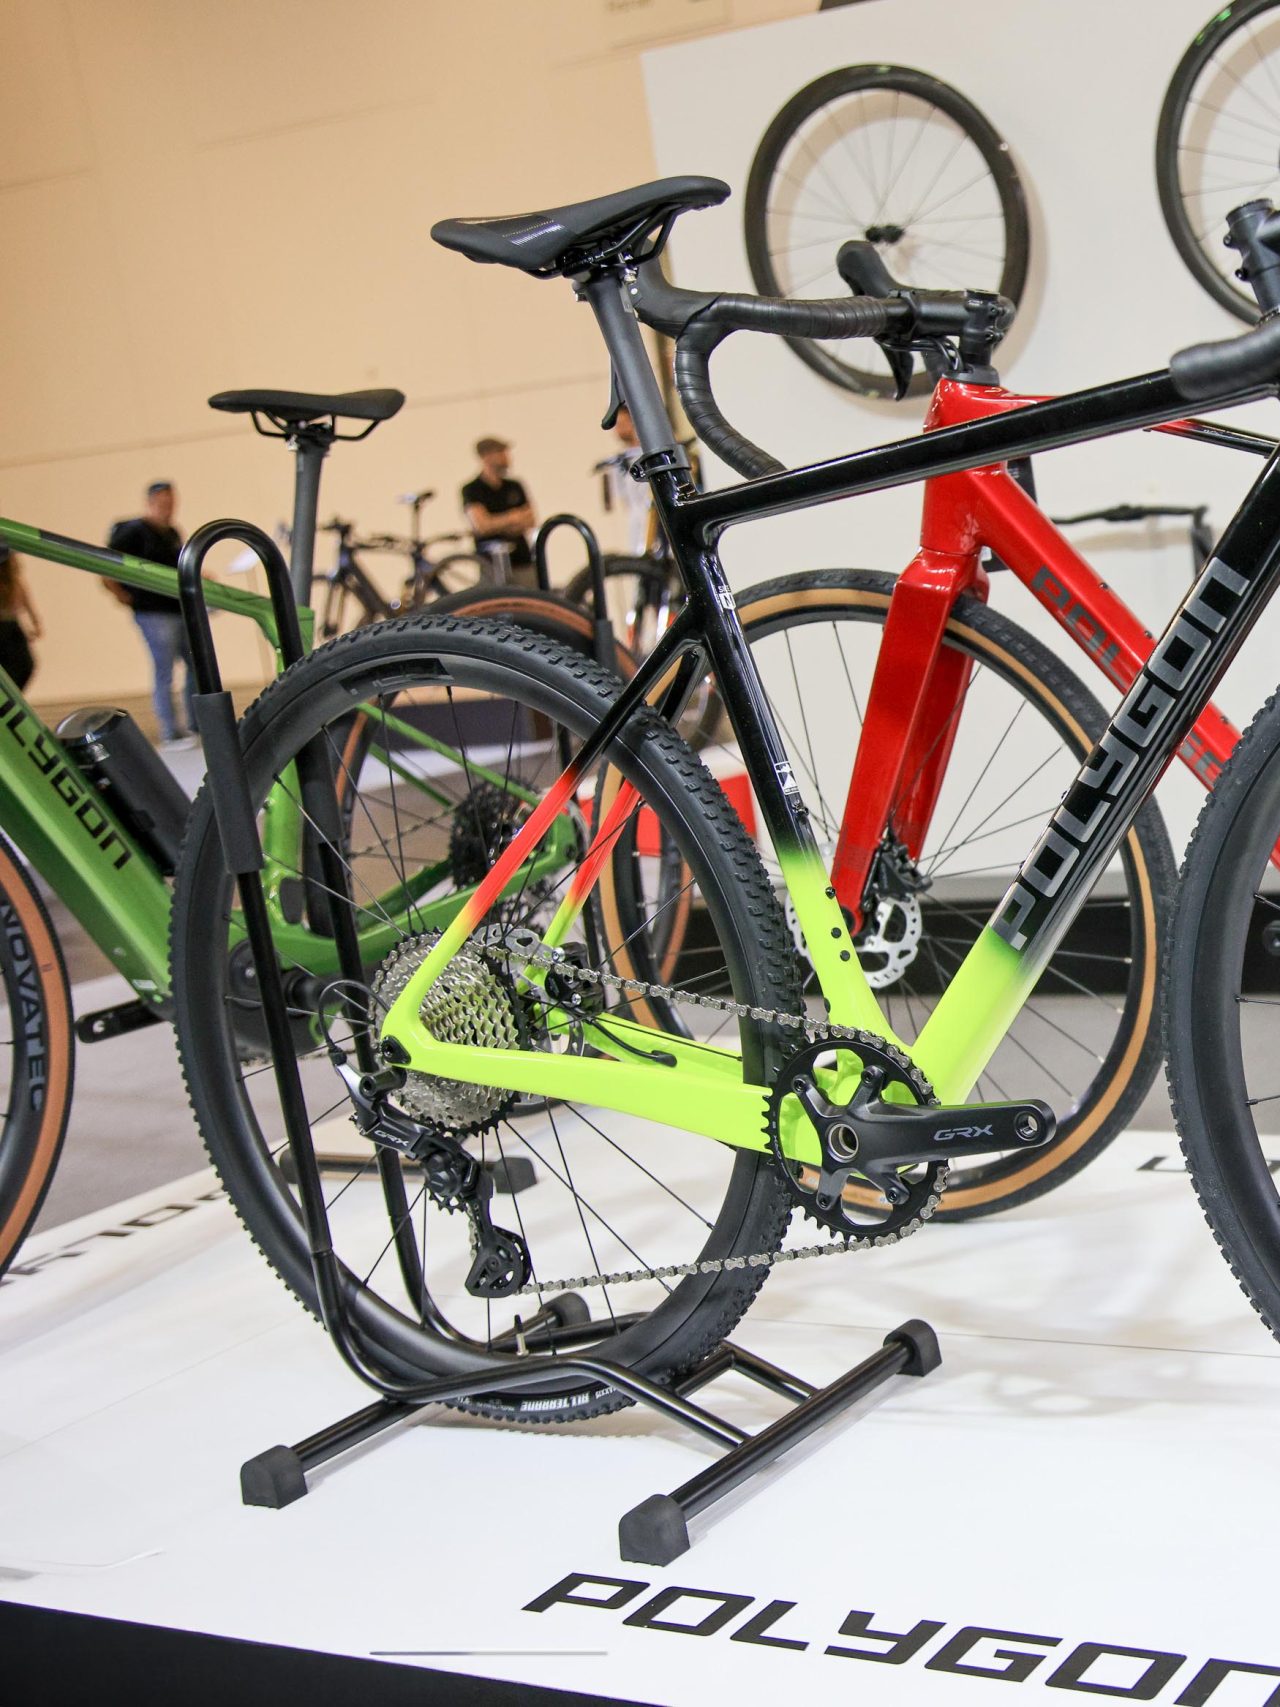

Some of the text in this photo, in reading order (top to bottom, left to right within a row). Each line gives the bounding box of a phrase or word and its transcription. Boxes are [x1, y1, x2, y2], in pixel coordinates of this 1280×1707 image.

[991, 556, 1250, 951] POLYGON
[2, 905, 43, 1110] NOVATEC
[374, 1129, 410, 1147] GRX
[934, 1123, 994, 1142] GRX
